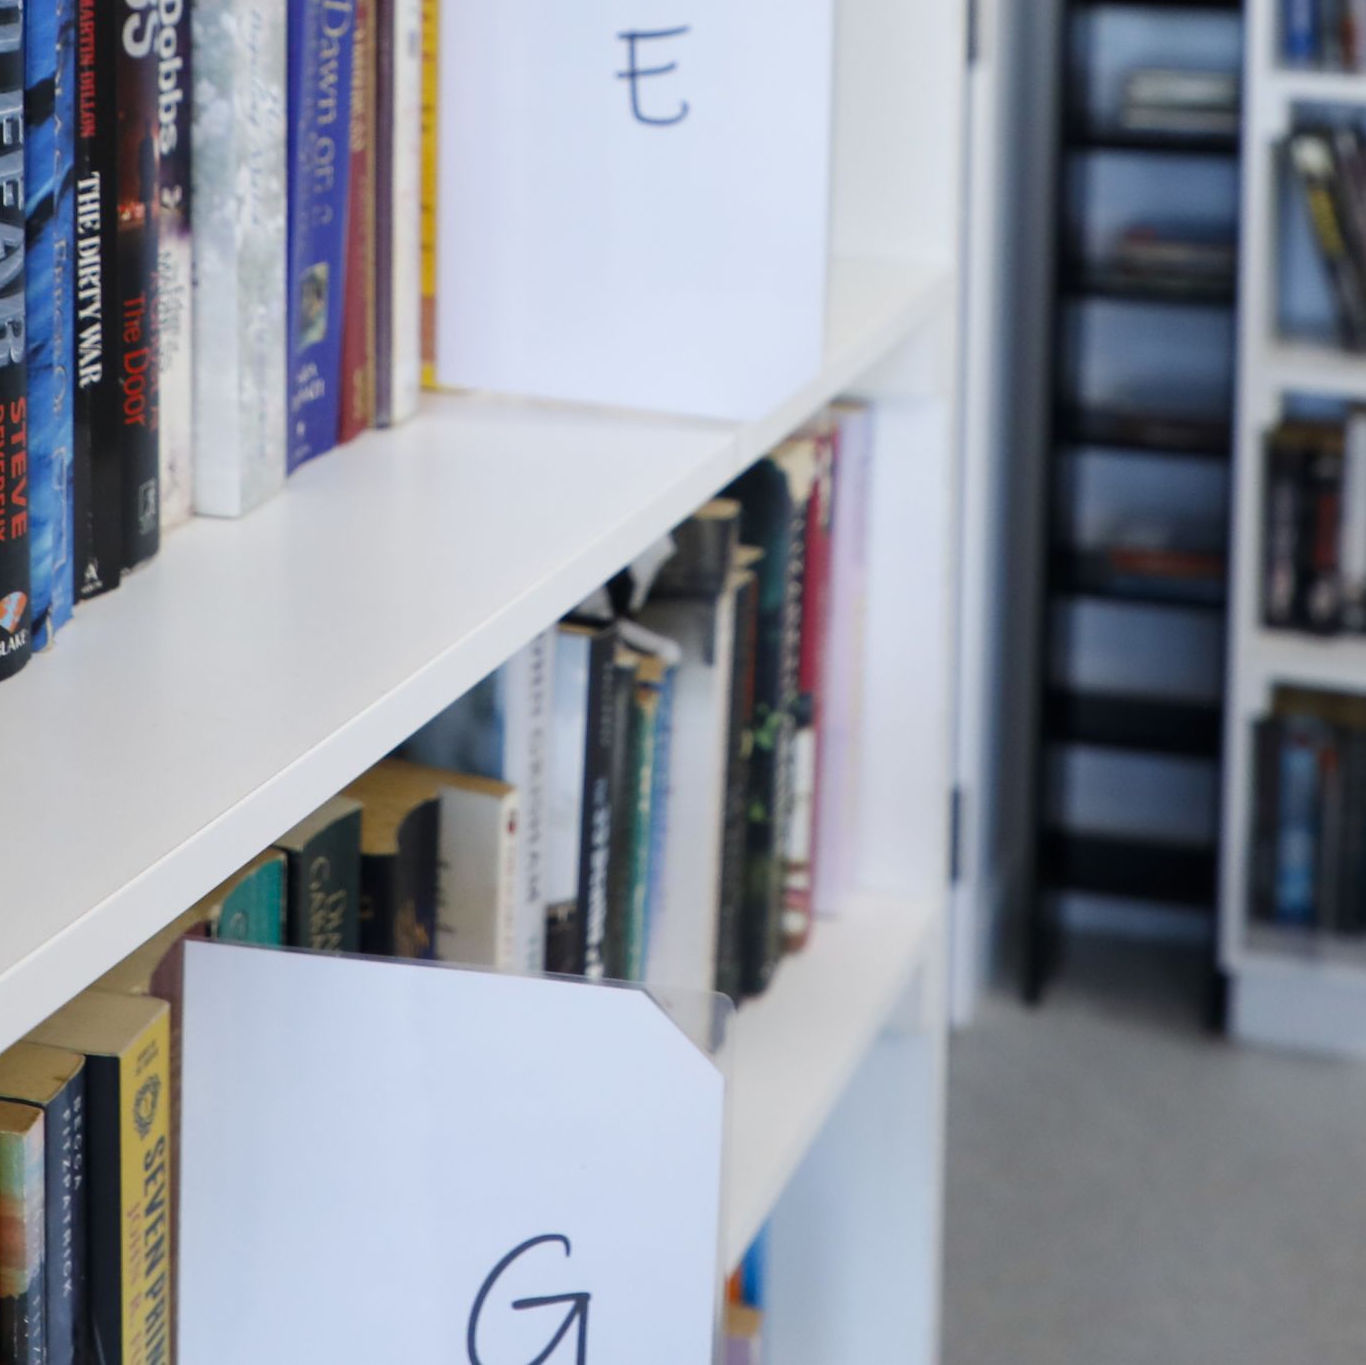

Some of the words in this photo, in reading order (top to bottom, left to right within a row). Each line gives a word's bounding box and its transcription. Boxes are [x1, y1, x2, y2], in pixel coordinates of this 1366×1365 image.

[79, 70, 96, 139] DILLON
[614, 23, 692, 128] E
[78, 171, 101, 234] THE
[312, 135, 336, 194] on
[77, 238, 102, 320] DIRTY
[122, 292, 146, 344] The
[78, 326, 103, 389] WAR
[122, 346, 152, 428] Door
[9, 395, 28, 541] STEVE
[60, 1107, 75, 1301] FITZPATRICK
[142, 1134, 167, 1280] SEVEN
[142, 1273, 168, 1365] PRIN
[466, 1233, 591, 1365] G
